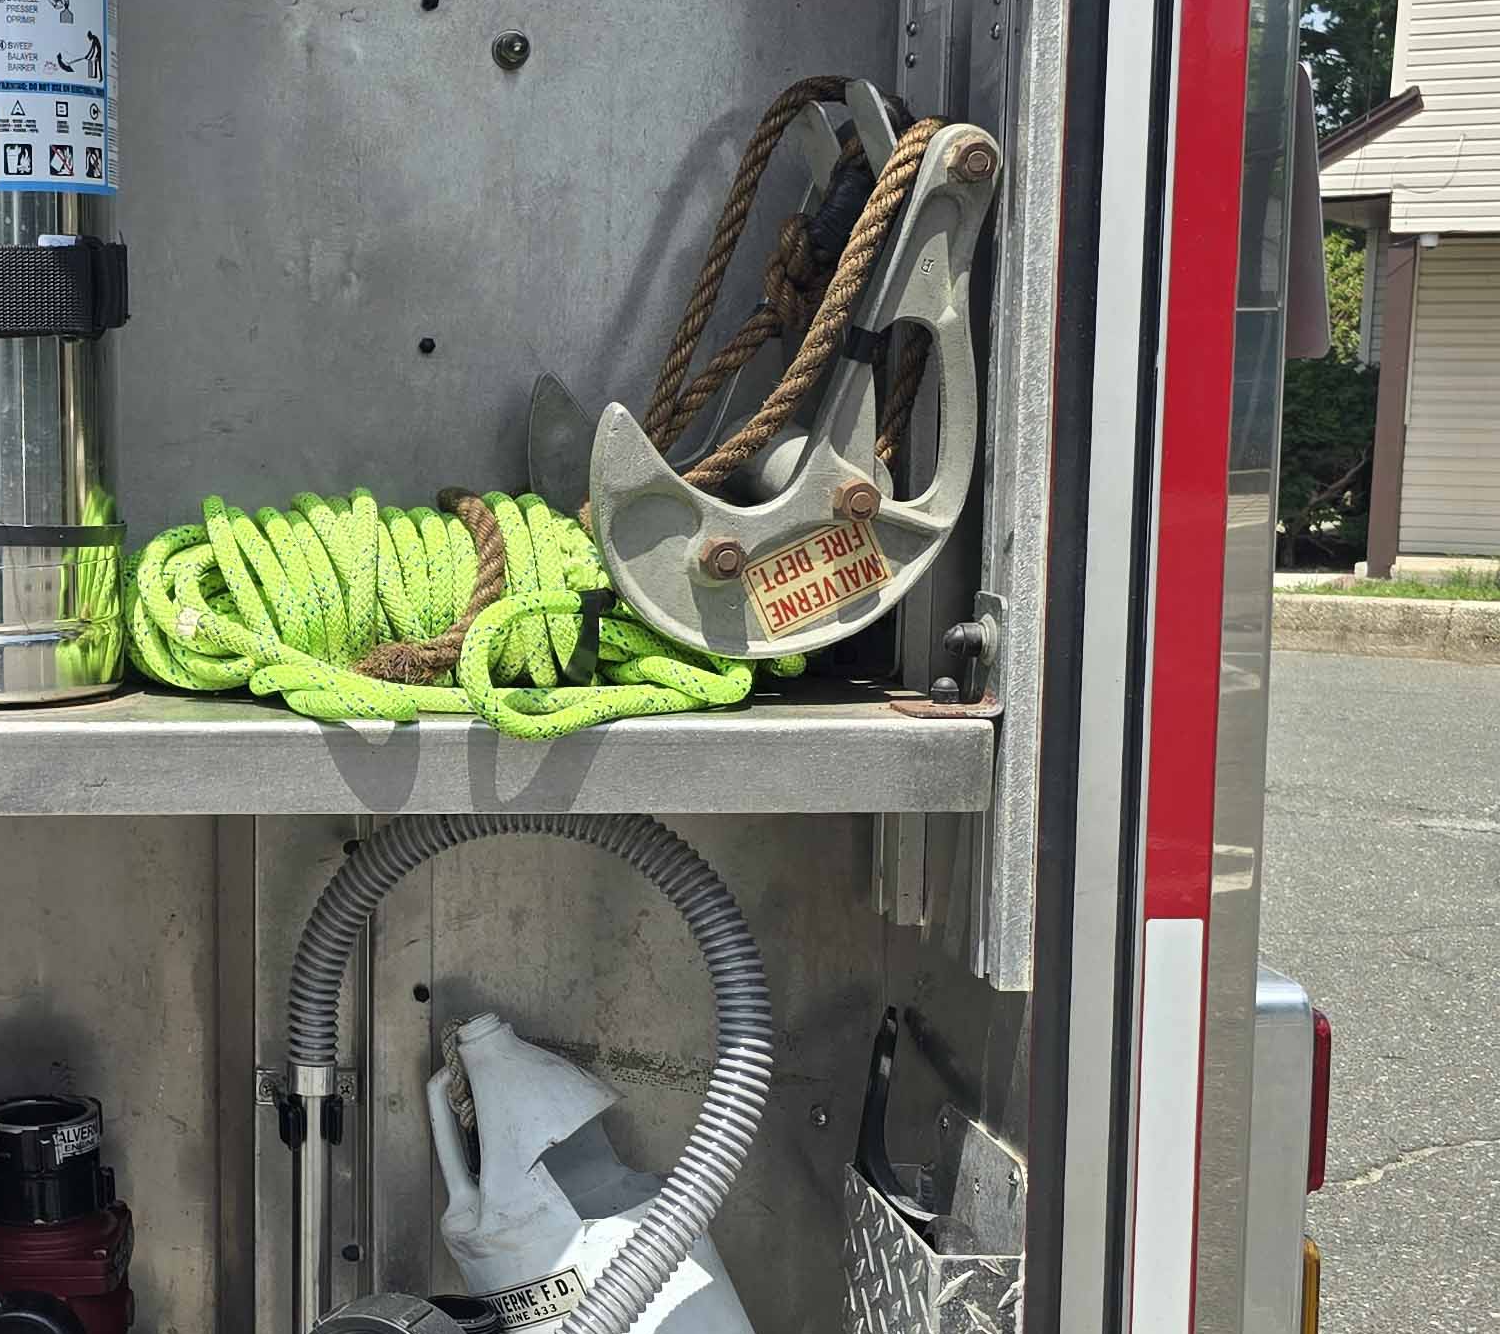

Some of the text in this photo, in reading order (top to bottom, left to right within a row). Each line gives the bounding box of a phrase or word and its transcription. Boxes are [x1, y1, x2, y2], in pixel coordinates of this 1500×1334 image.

[8, 42, 33, 50] SWEEP
[752, 522, 865, 593] FIRE DEPT.
[766, 553, 883, 628] MALVERNE
[540, 1278, 574, 1301] F.D.
[534, 1303, 557, 1317] 433
